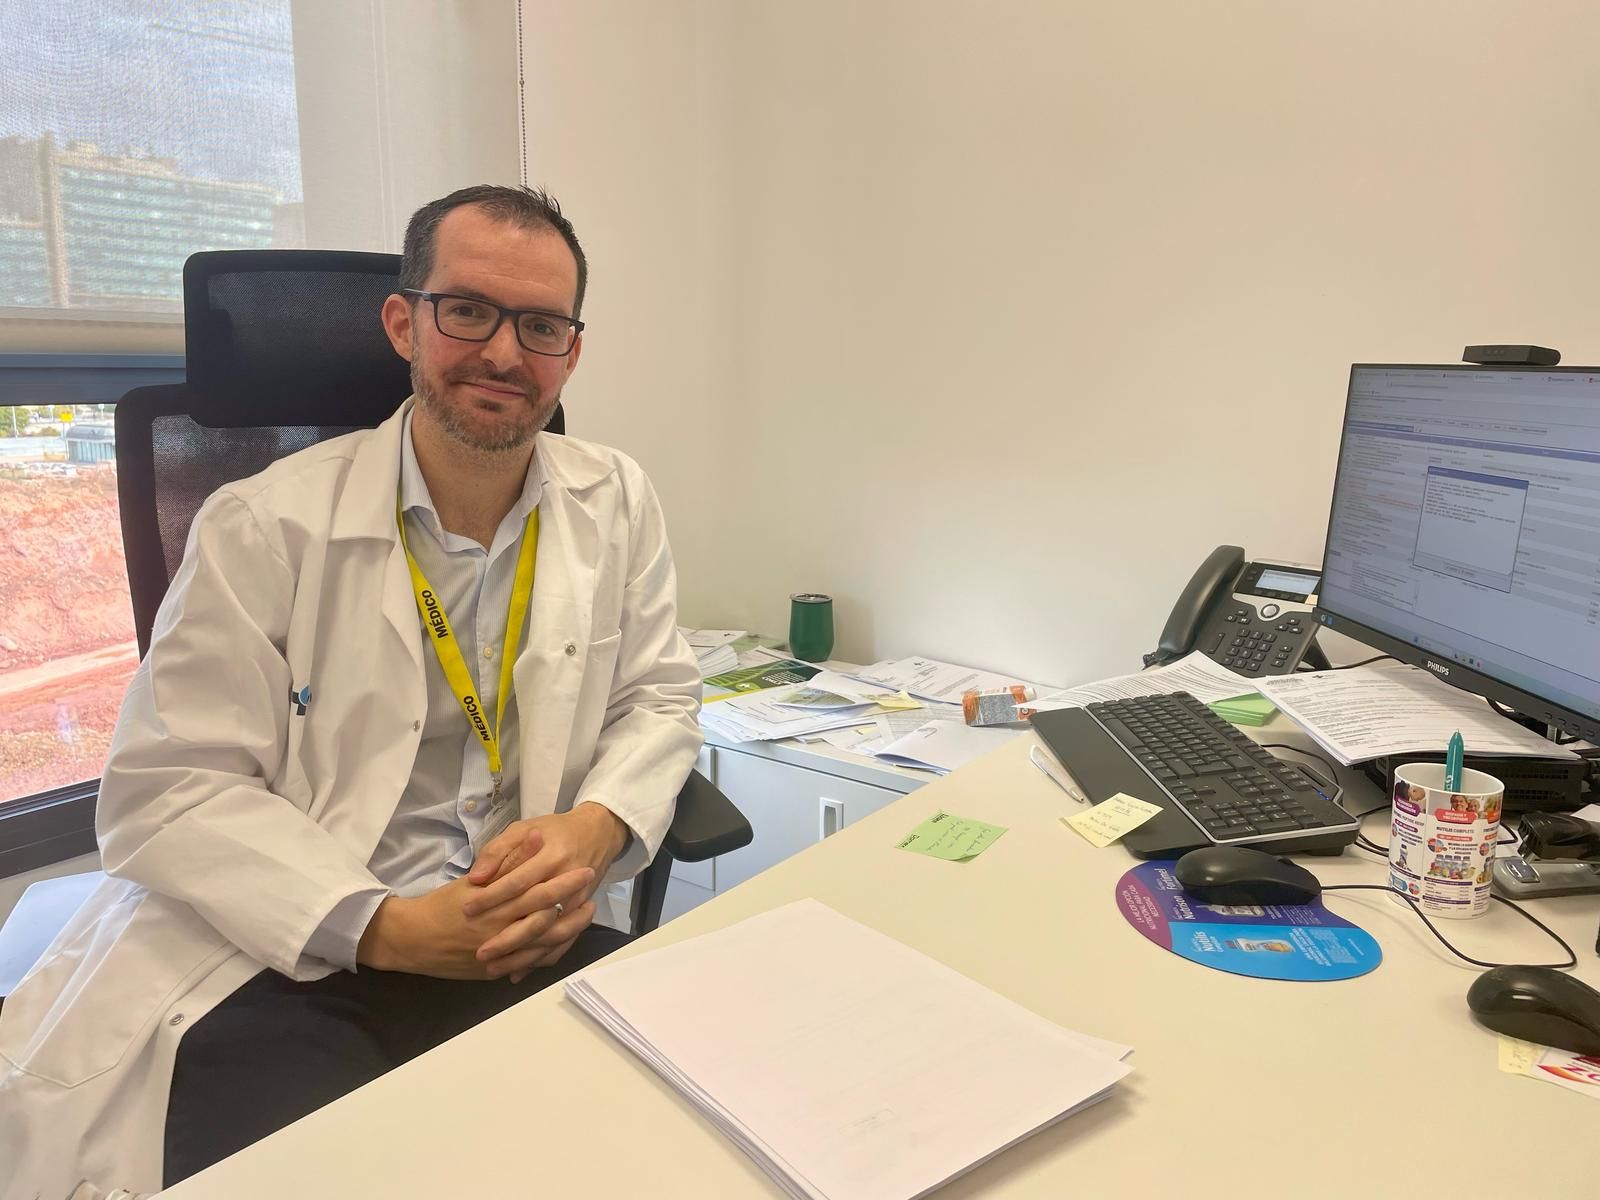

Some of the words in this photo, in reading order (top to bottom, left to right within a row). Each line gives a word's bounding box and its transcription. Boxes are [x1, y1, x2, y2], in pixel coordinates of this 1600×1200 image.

[422, 590, 448, 638] MÉDICO
[1427, 660, 1449, 676] PHILIPS
[464, 696, 490, 742] MÉDICO
[1154, 868, 1178, 890] Fortimel
[1174, 896, 1196, 920] Nutrison
[1194, 932, 1216, 952] Nutilis
